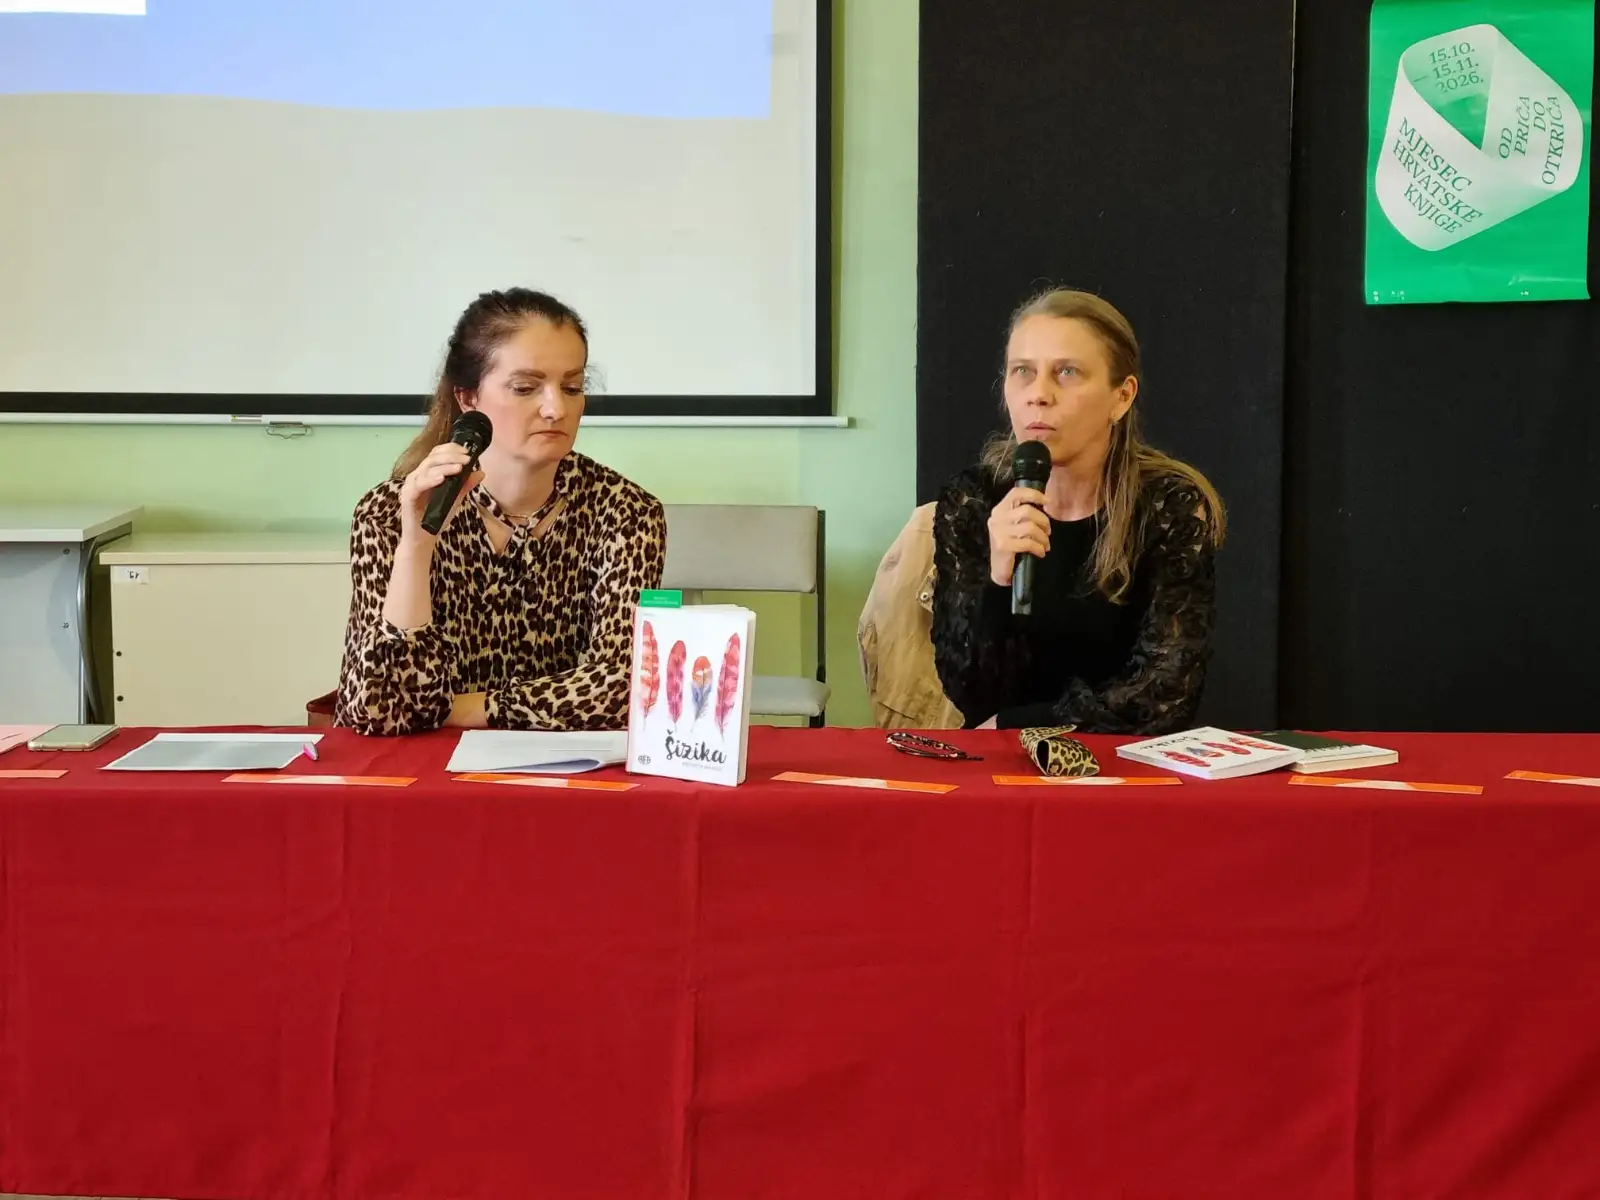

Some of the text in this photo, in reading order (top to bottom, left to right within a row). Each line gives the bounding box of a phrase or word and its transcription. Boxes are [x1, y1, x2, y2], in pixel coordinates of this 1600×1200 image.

[1429, 42, 1475, 64] 15.10.
[1433, 57, 1479, 79] 15.11.
[1436, 71, 1484, 93] 2026.
[1514, 96, 1530, 156] PRIČA
[1533, 101, 1546, 132] DO
[1399, 117, 1472, 191] MJESEC
[1498, 128, 1512, 158] OD
[1541, 96, 1564, 184] OTKRIĆA
[1393, 139, 1483, 222] HRVATSKE
[1404, 183, 1462, 233] KNJIGE
[665, 729, 727, 764] Šizika
